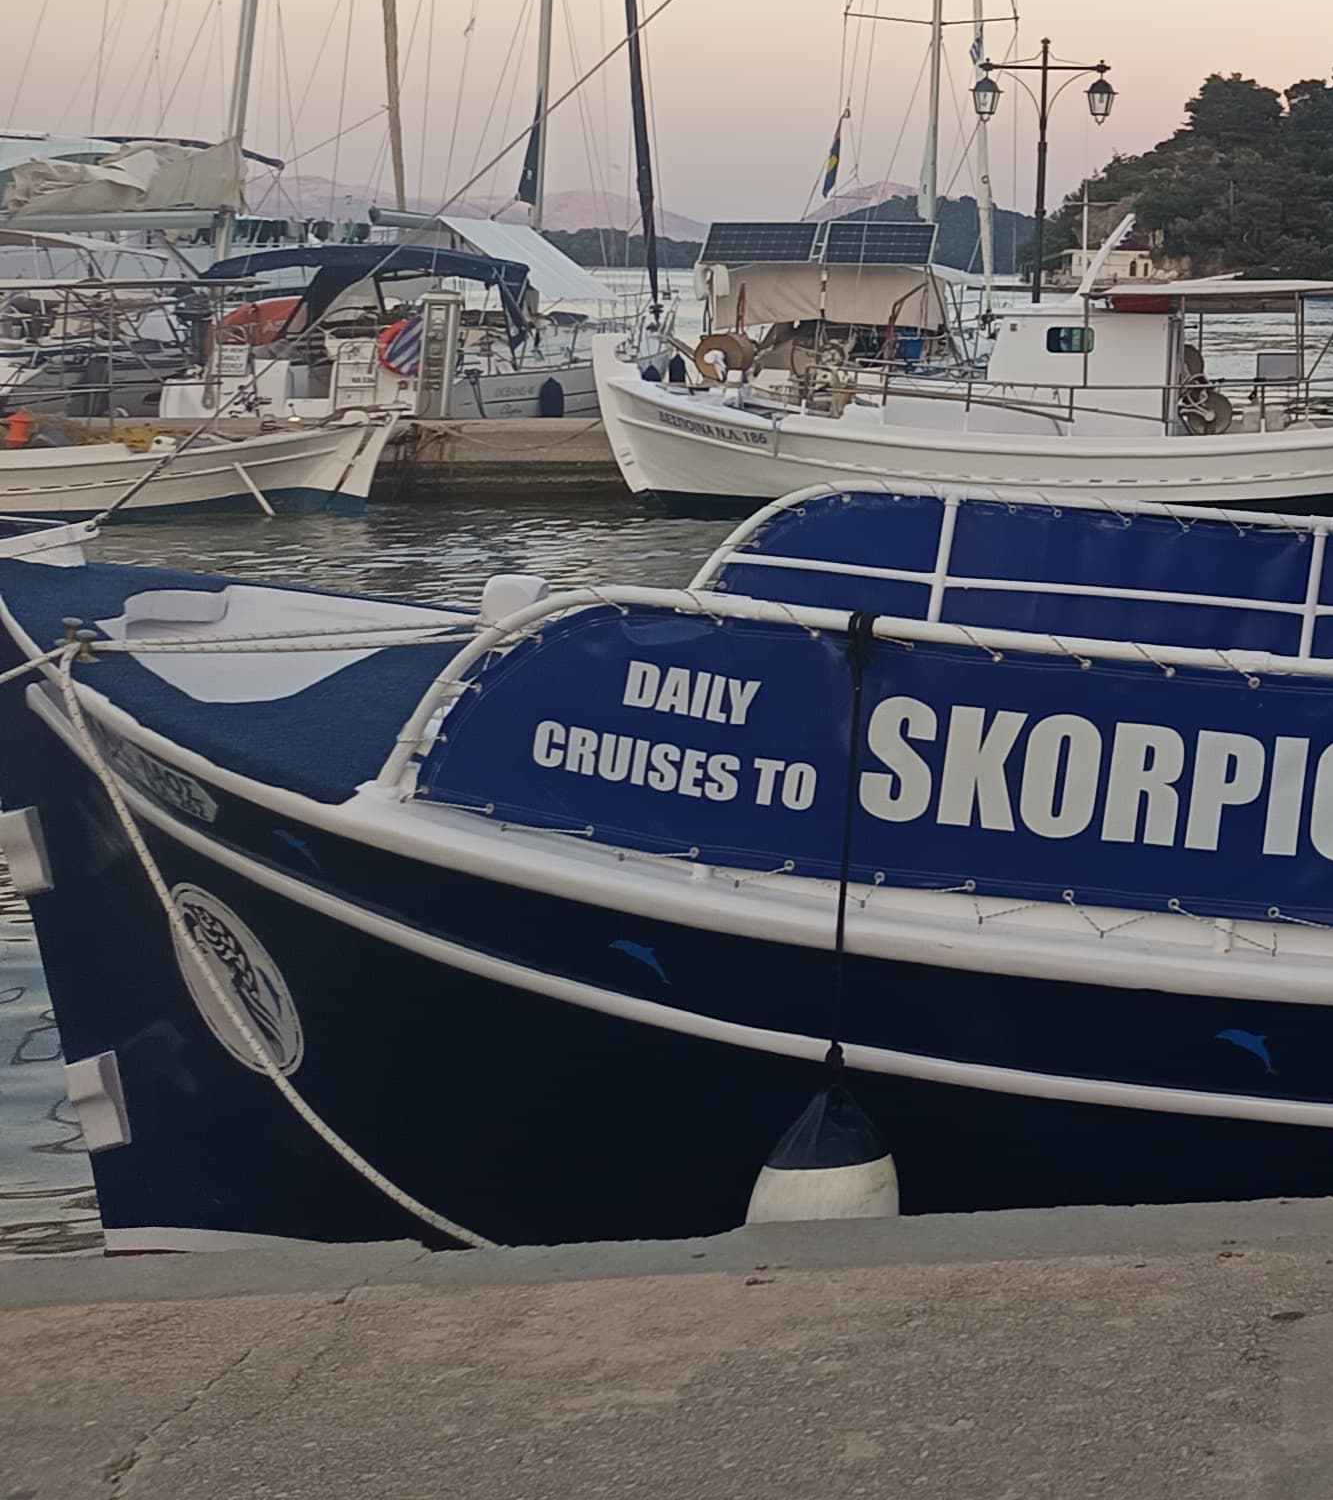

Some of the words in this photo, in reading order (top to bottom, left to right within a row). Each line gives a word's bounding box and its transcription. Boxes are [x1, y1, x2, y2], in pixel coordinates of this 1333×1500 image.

[622, 660, 761, 725] DAILY
[532, 719, 740, 802] CRUISES
[753, 756, 818, 810] TO
